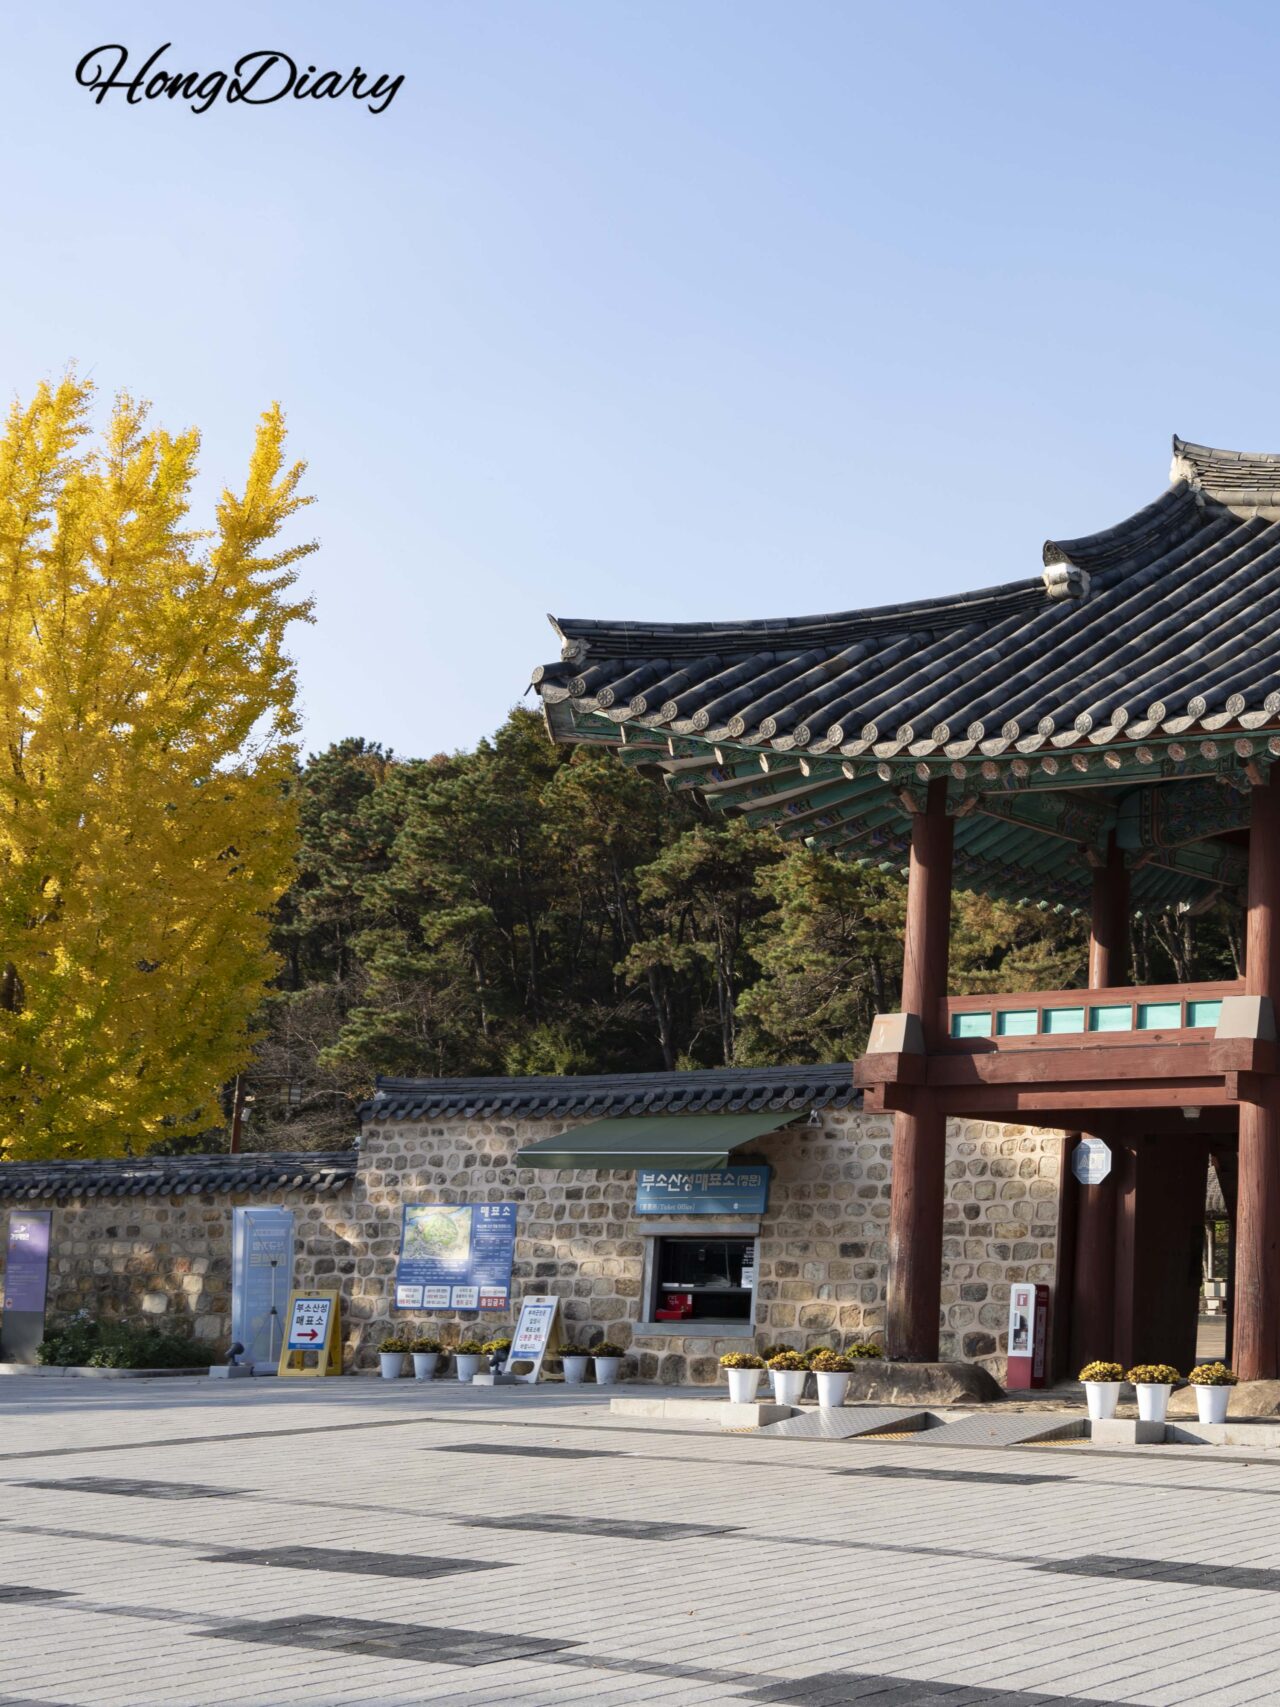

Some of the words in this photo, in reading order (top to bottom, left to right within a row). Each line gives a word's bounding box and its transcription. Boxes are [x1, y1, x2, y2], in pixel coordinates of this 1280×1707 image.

[480, 1206, 511, 1218] 매표소
[296, 1304, 328, 1313] 부소산성
[296, 1315, 324, 1326] 매표소
